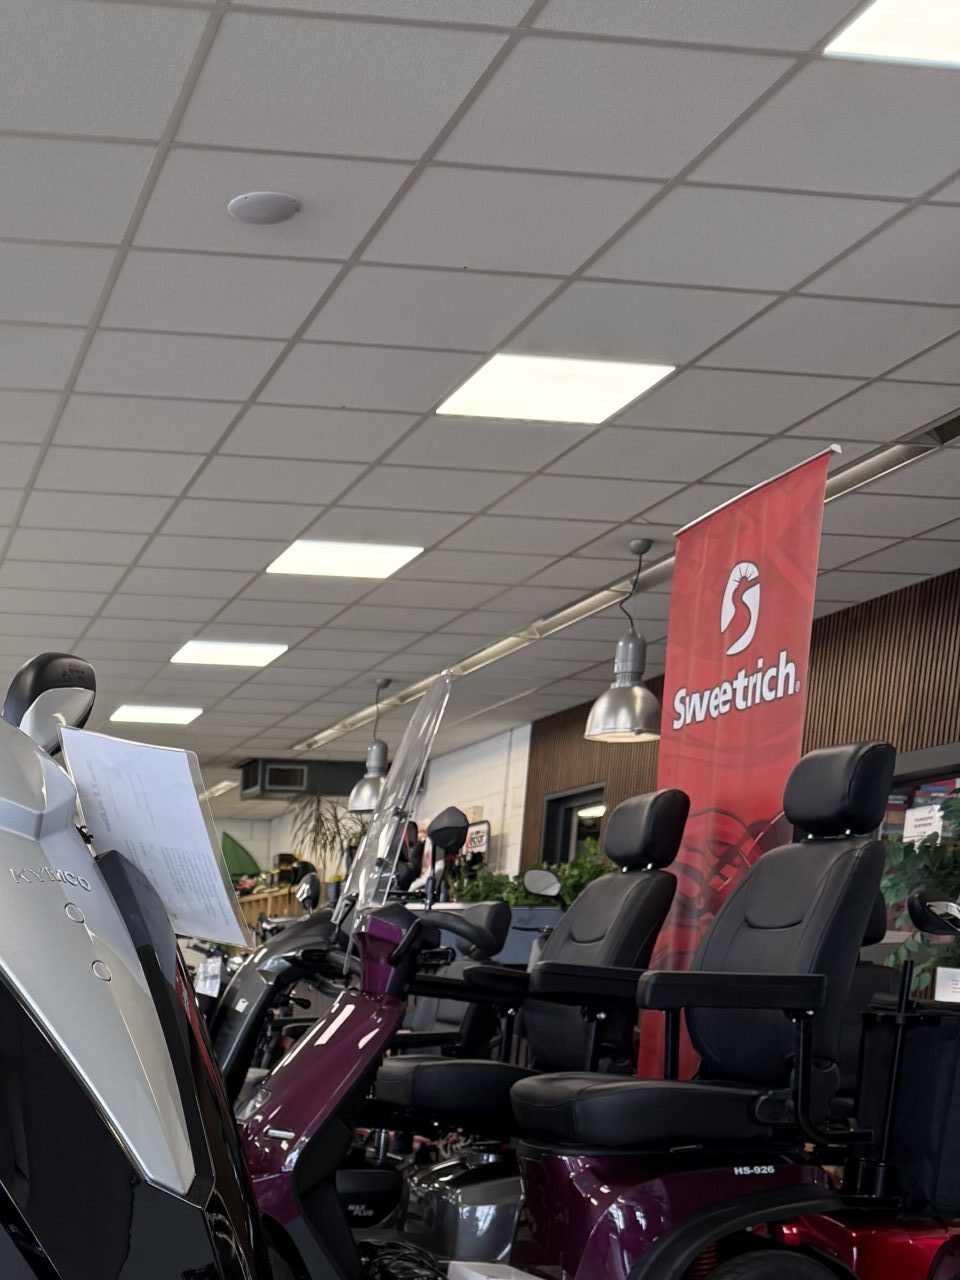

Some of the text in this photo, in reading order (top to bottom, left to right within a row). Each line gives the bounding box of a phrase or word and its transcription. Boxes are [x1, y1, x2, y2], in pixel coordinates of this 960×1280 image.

[672, 650, 797, 730] Sweetrich
[9, 866, 92, 892] KYMCO
[733, 1165, 775, 1175] HS-926
